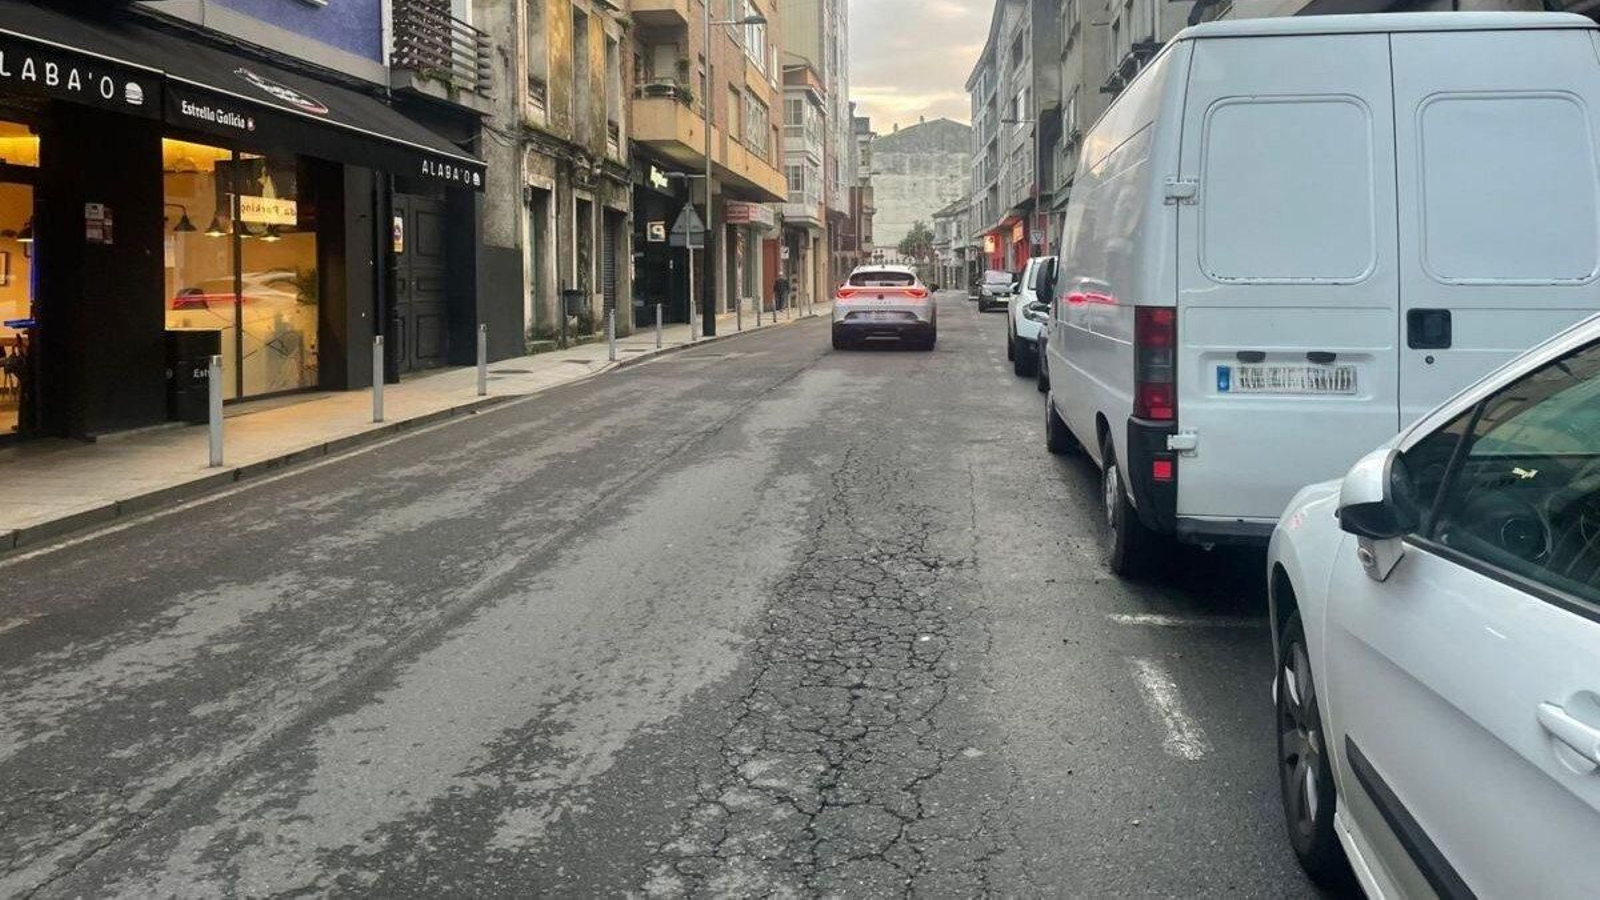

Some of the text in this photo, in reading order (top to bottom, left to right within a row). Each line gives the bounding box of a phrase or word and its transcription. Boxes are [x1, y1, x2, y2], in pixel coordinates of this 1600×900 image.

[182, 100, 246, 129] Estrella Galicia
[422, 160, 470, 184] ALABA'O
[193, 369, 210, 378] Est
